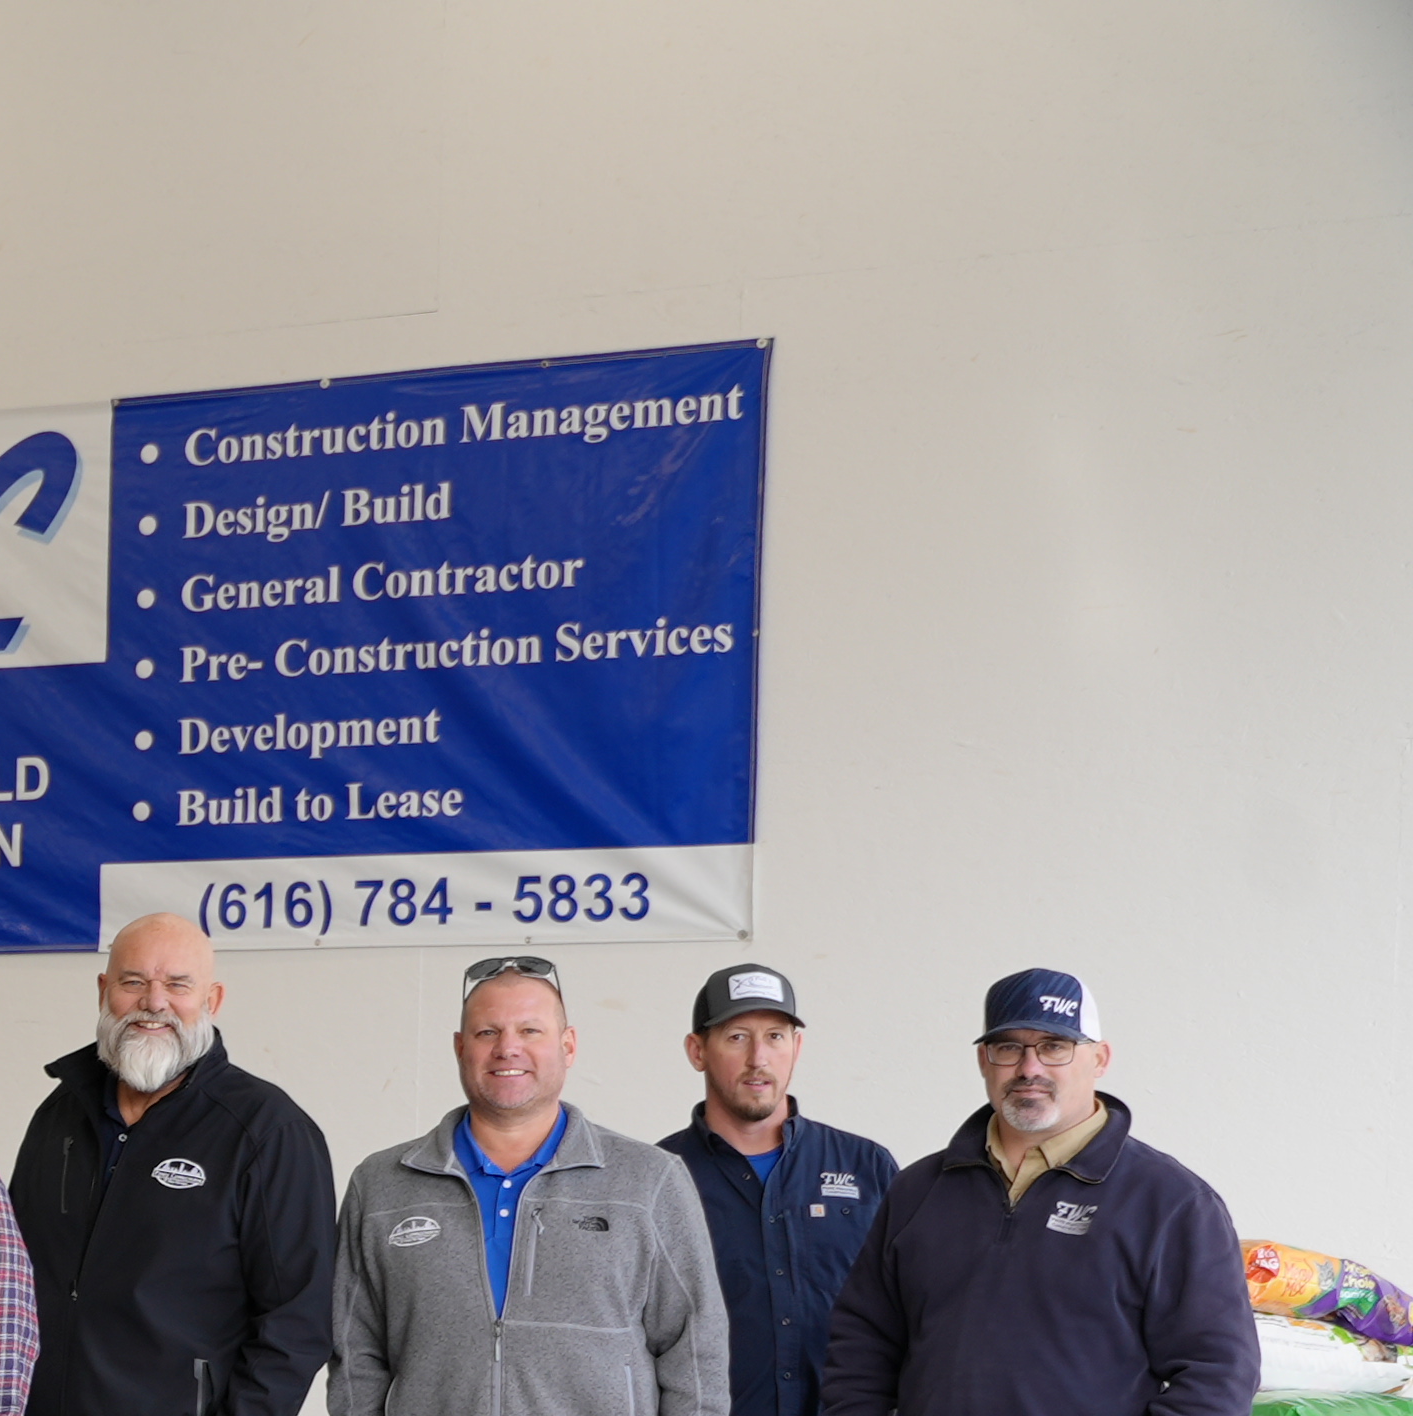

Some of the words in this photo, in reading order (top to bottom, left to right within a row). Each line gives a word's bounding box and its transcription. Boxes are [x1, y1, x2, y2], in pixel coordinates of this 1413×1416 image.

[184, 411, 445, 467] Construction
[460, 383, 744, 444] Management
[183, 491, 329, 542] Design/
[342, 482, 450, 527] Build
[181, 566, 339, 612] General
[353, 554, 584, 603] Contractor
[180, 646, 263, 683] Pre-
[274, 628, 541, 678] Construction
[555, 617, 733, 663] Services
[179, 709, 440, 759] Development
[177, 787, 282, 826] Build
[296, 787, 332, 822] to
[345, 782, 462, 821] Lease
[198, 878, 333, 936] (616)
[354, 877, 453, 927] 784
[512, 872, 650, 923] 5833
[1039, 995, 1078, 1017] FWC
[820, 1172, 855, 1186] FWC
[1056, 1201, 1098, 1221] FWC
